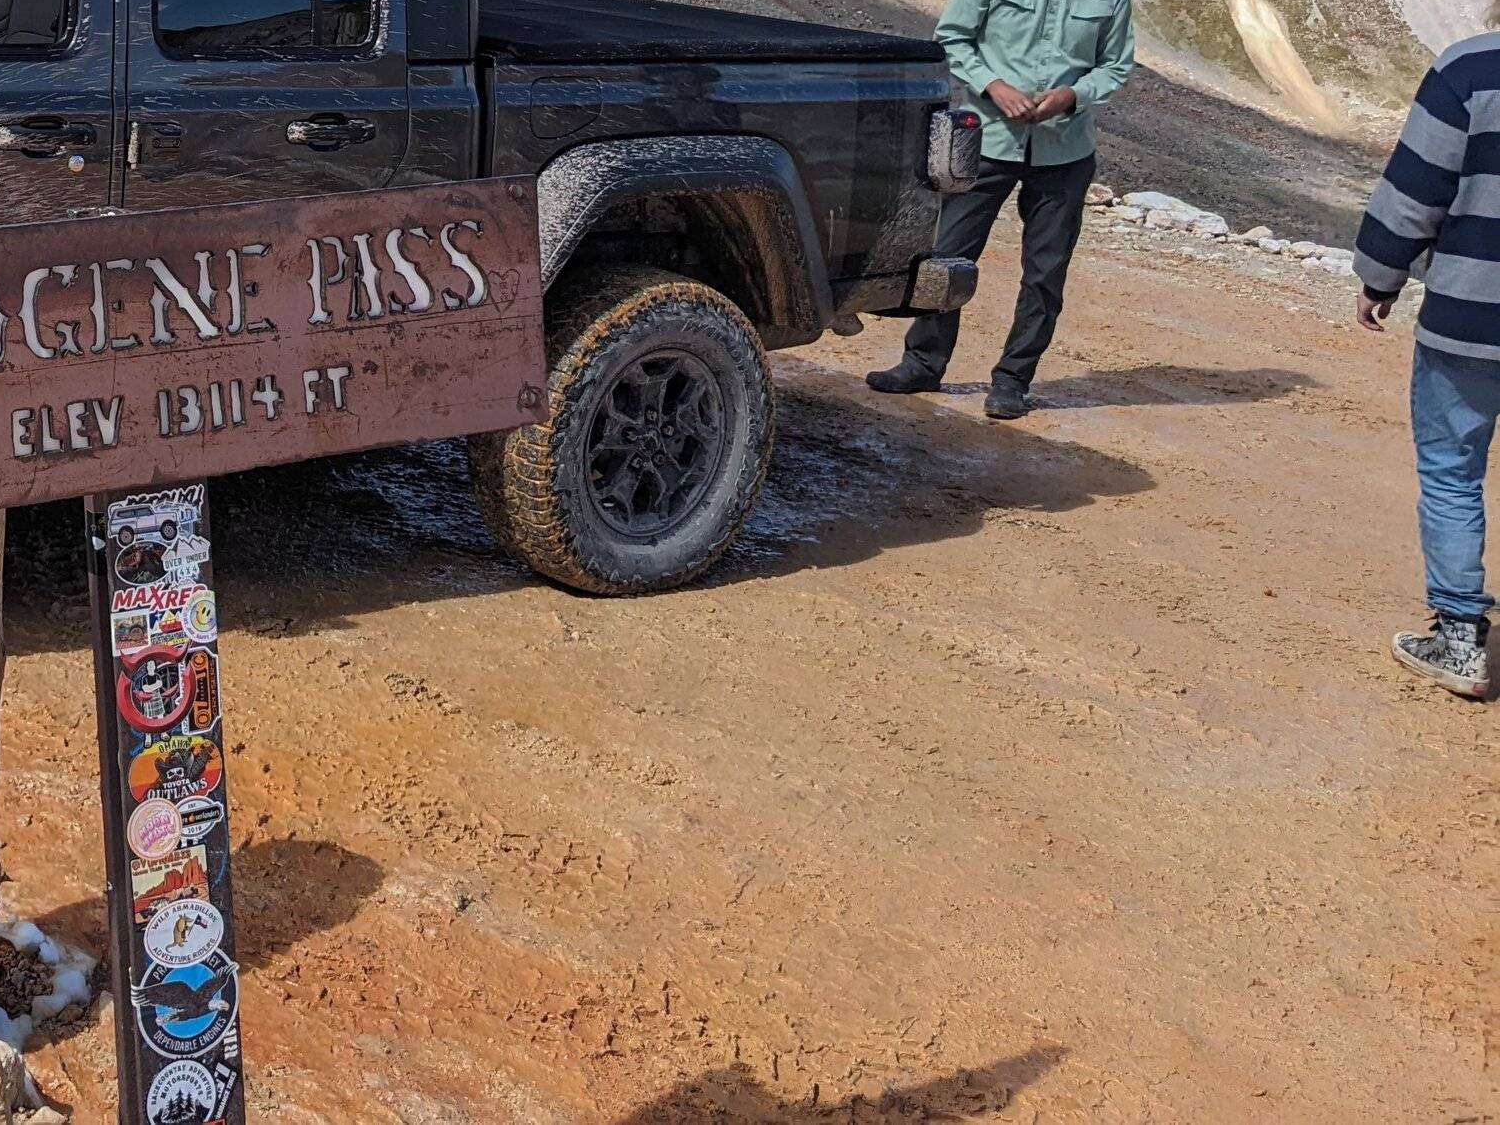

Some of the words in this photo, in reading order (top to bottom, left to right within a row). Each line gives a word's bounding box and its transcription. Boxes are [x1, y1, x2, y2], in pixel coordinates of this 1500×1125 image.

[11, 395, 125, 459] ELEV
[157, 375, 285, 438] 13114
[303, 365, 353, 416] FT
[164, 557, 182, 570] OVER
[186, 551, 207, 563] UNDER
[147, 777, 208, 800] OUTLAWS
[163, 778, 190, 789] TOYOTA
[151, 912, 170, 930] WILD
[172, 904, 218, 923] ARMADILLOS
[153, 946, 191, 962] ADVENTURE
[192, 938, 216, 959] RIDERS
[153, 1029, 198, 1052] DEPENDABLE
[200, 1017, 227, 1046] ENGINES
[160, 1074, 204, 1099] MOTORSPORTS
[189, 1065, 213, 1101] ADVENTURE
